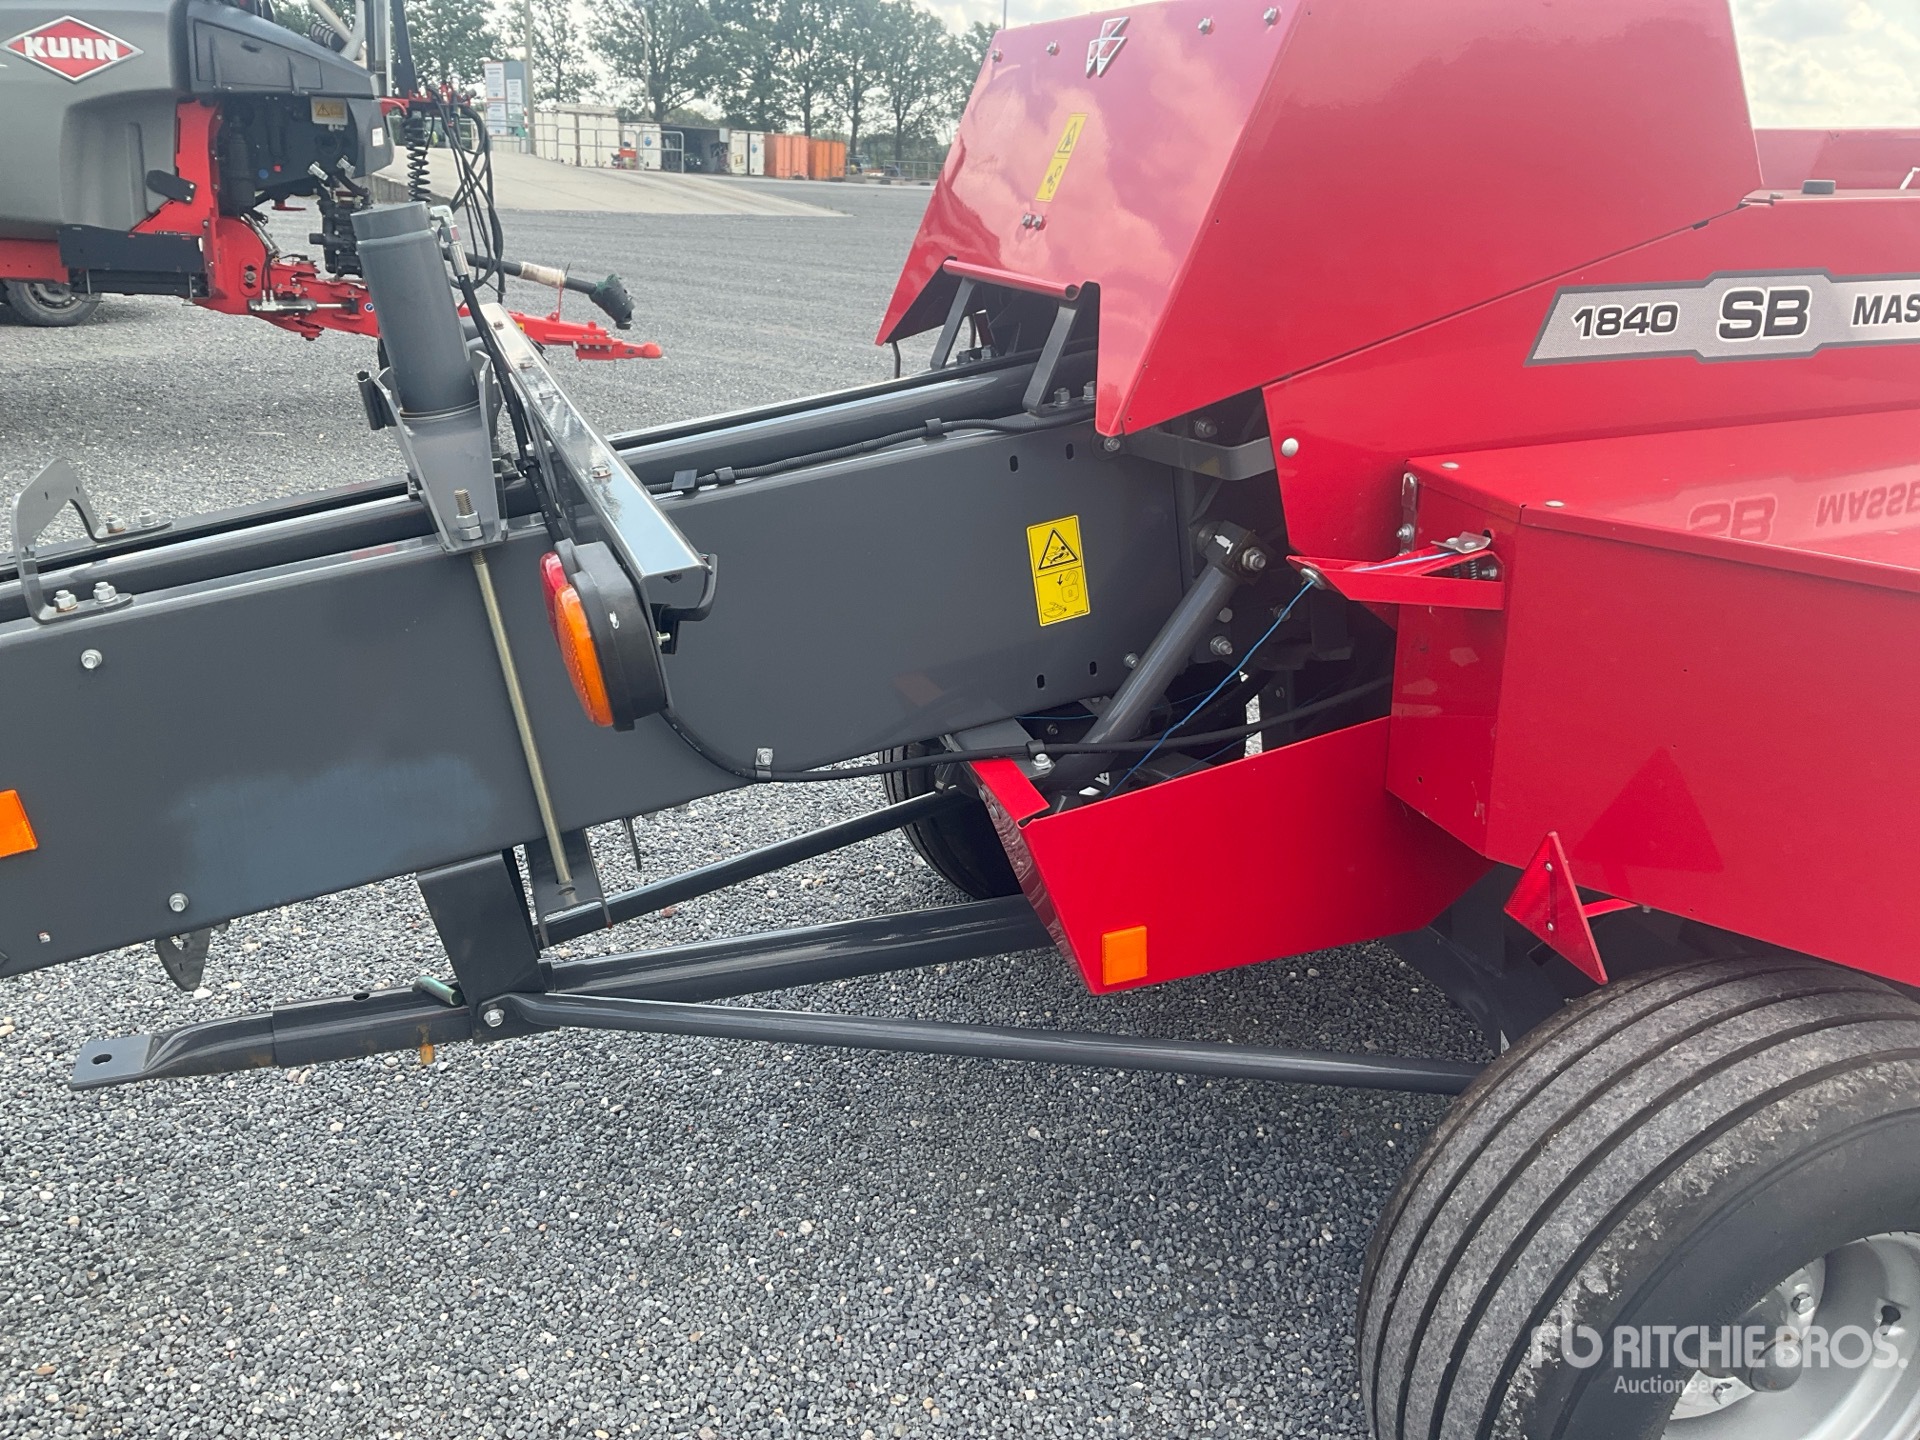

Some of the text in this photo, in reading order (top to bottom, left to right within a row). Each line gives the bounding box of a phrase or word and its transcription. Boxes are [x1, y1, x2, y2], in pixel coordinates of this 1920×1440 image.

[23, 36, 118, 60] KUHN
[1573, 305, 1679, 338] 1840
[1718, 288, 1812, 341] SB
